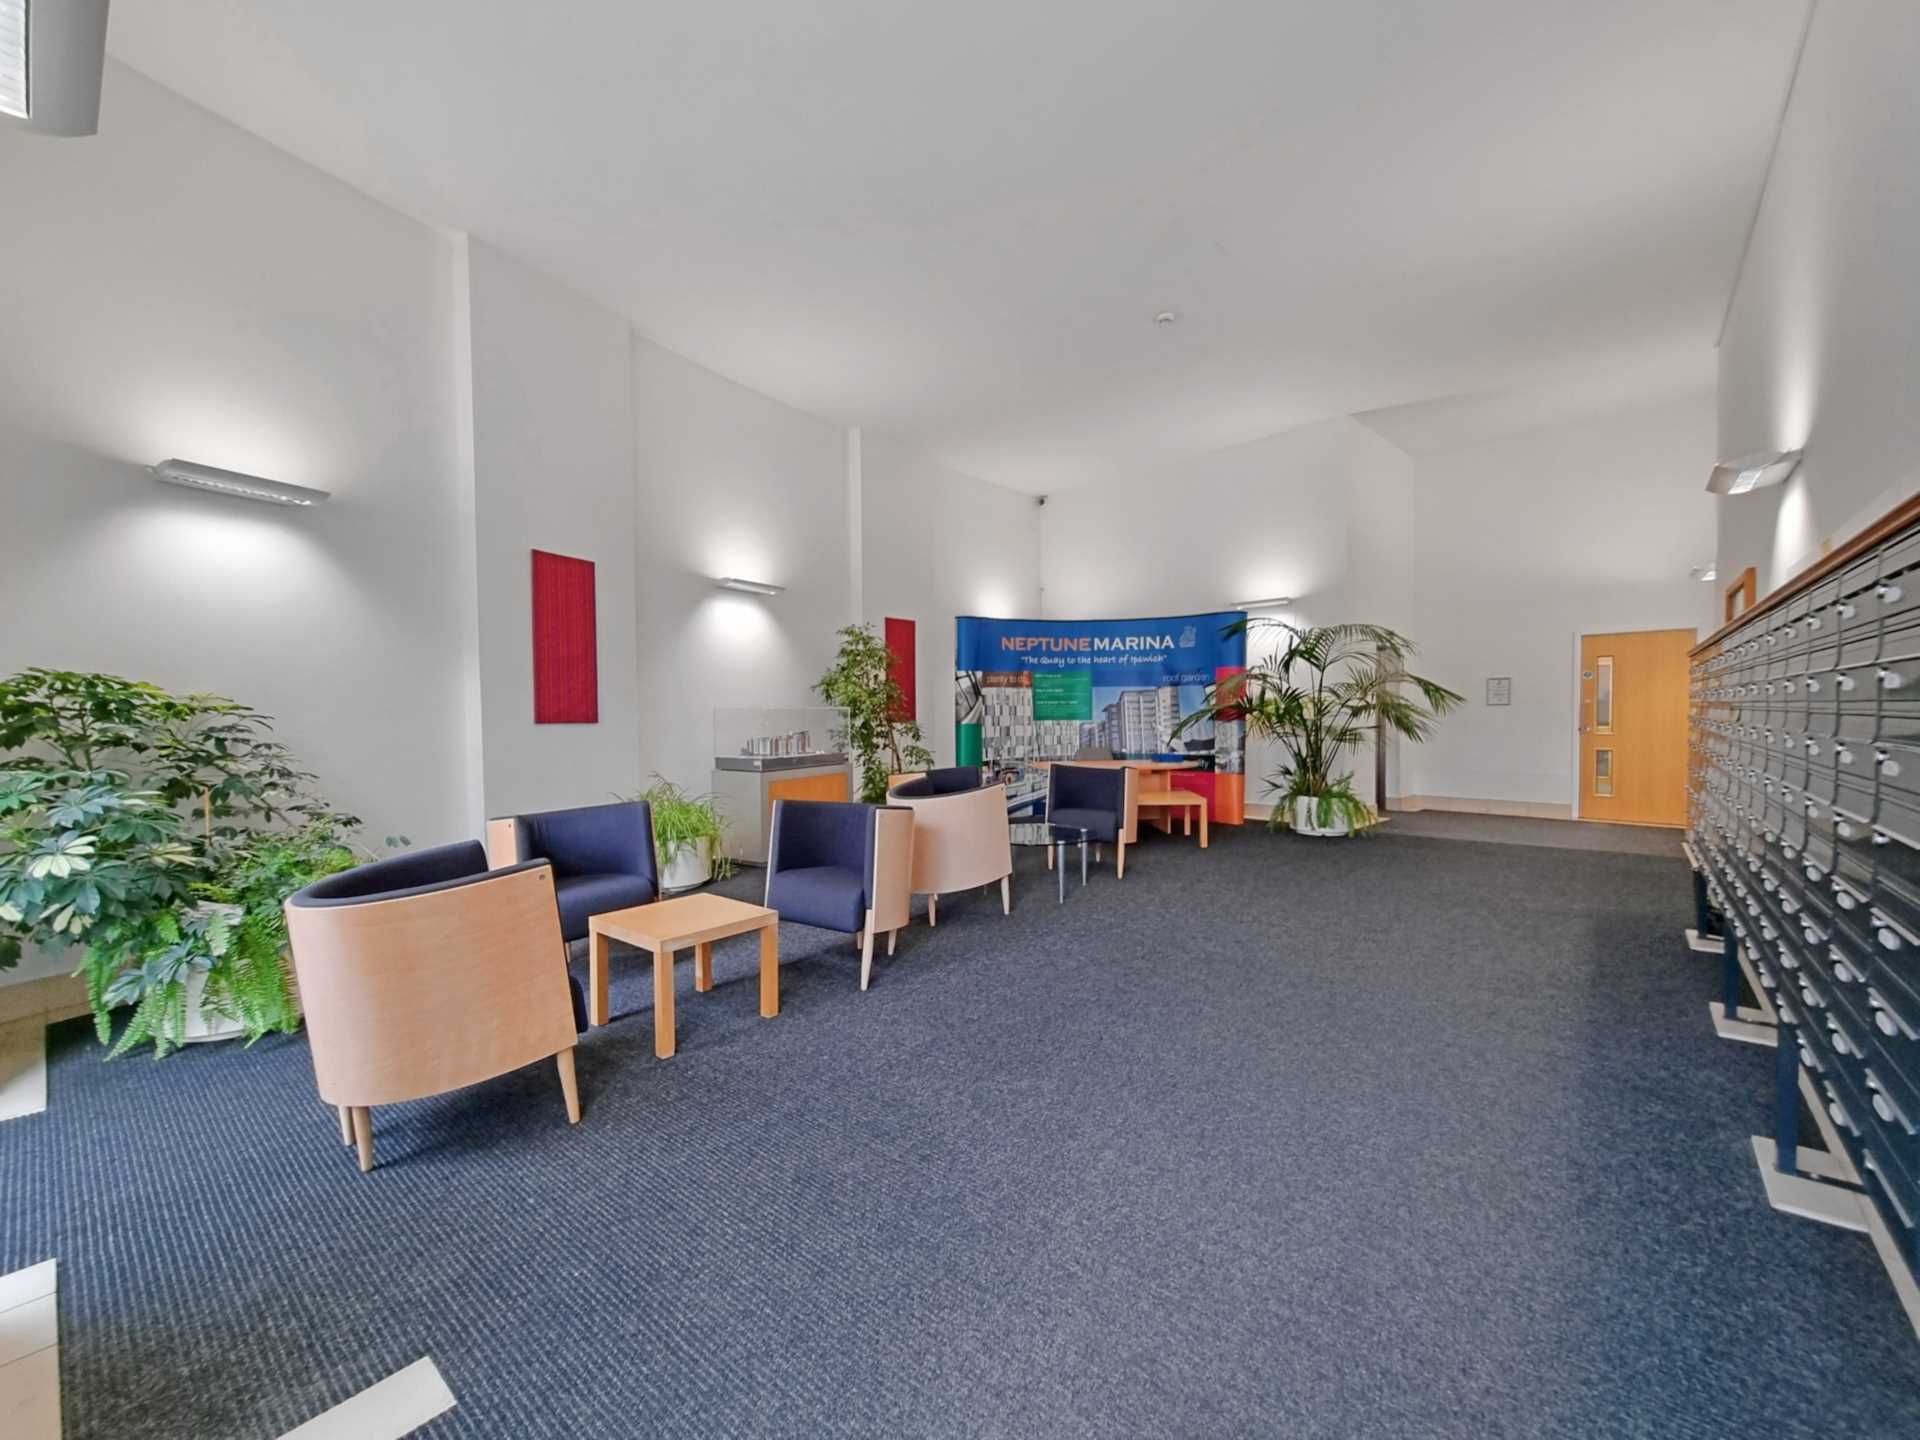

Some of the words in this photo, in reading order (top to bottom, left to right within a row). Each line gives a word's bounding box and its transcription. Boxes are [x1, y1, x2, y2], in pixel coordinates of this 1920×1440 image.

[1067, 656, 1077, 664] to
[1077, 655, 1091, 664] the
[1093, 655, 1117, 664] heart
[1118, 654, 1130, 666] of
